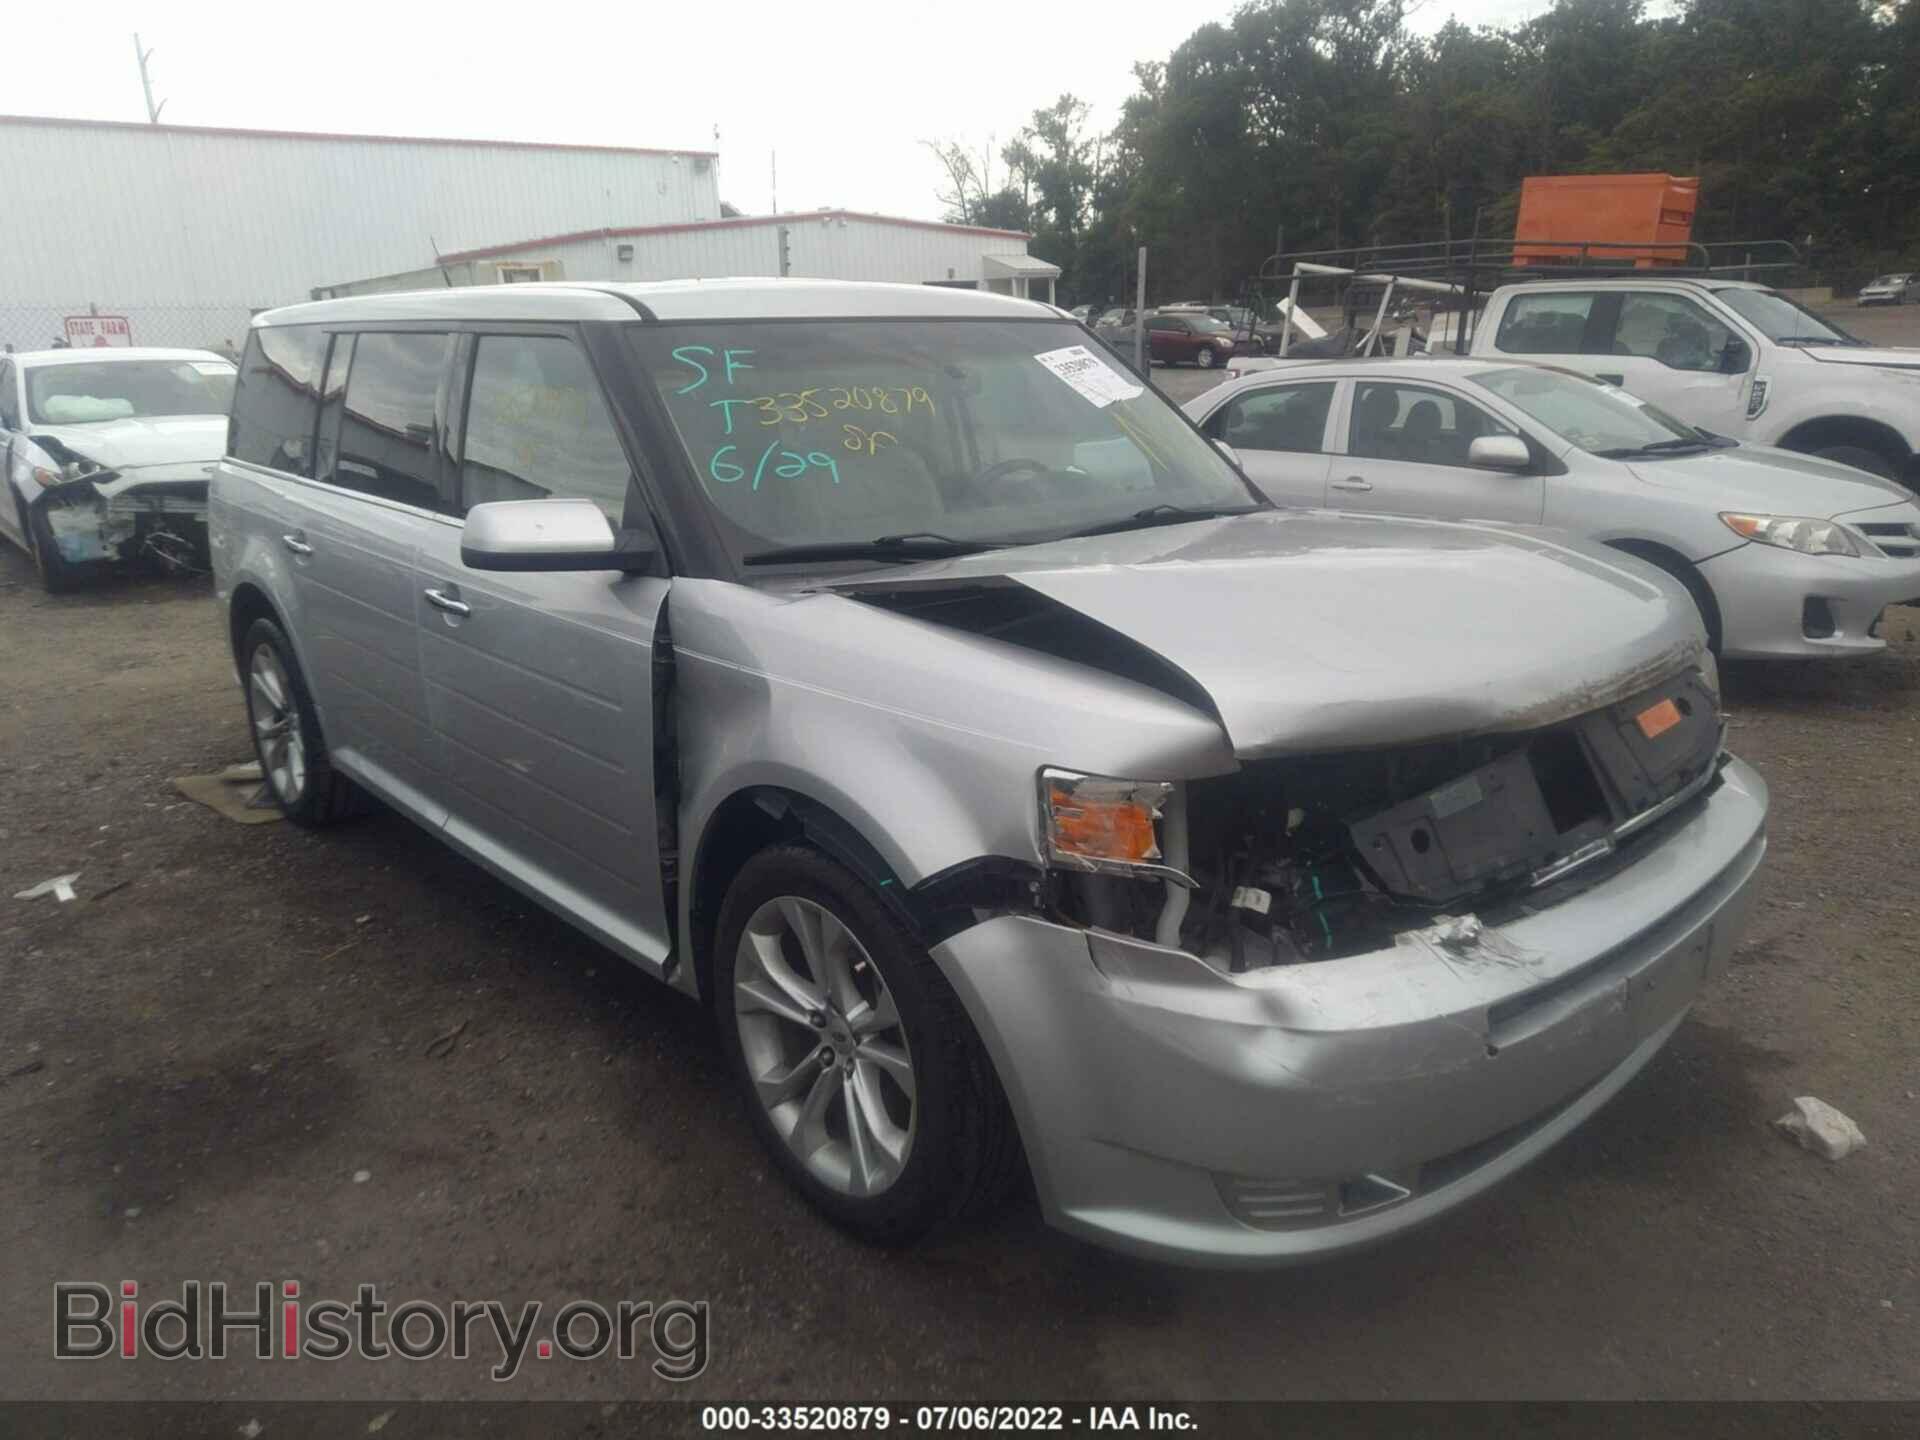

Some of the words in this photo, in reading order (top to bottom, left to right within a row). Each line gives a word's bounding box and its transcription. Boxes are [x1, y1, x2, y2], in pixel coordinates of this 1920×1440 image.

[68, 320, 96, 336] STATE
[100, 320, 128, 335] FARM
[752, 386, 936, 425] 33520879
[710, 438, 840, 491] 6/29
